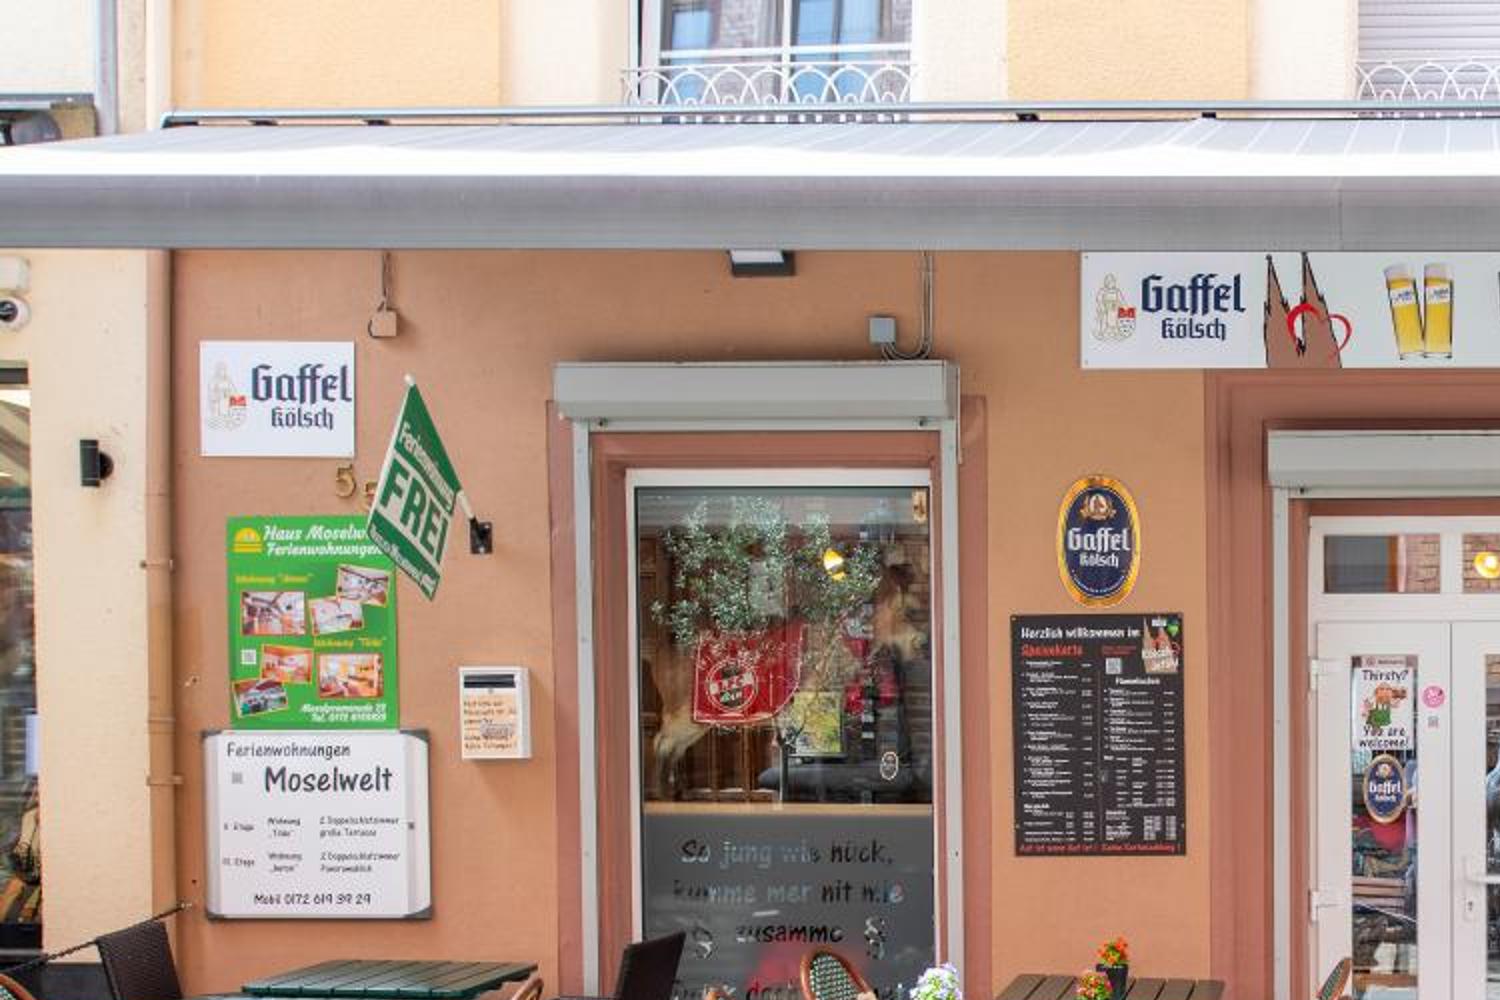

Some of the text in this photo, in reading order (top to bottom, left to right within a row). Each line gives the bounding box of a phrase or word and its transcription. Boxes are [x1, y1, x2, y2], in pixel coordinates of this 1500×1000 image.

[1141, 273, 1246, 316] Gaffel
[1161, 318, 1226, 342] Kölsch
[251, 364, 353, 404] Gaffel
[271, 407, 334, 430] Kölsch
[380, 458, 449, 565] FREI
[264, 525, 368, 541] Haus Moselw
[1067, 527, 1130, 552] Gaffel
[1361, 669, 1408, 681] Thirsty?
[227, 742, 351, 760] Ferienwohnungen
[264, 766, 393, 792] Moselwelt
[719, 841, 773, 870] jung
